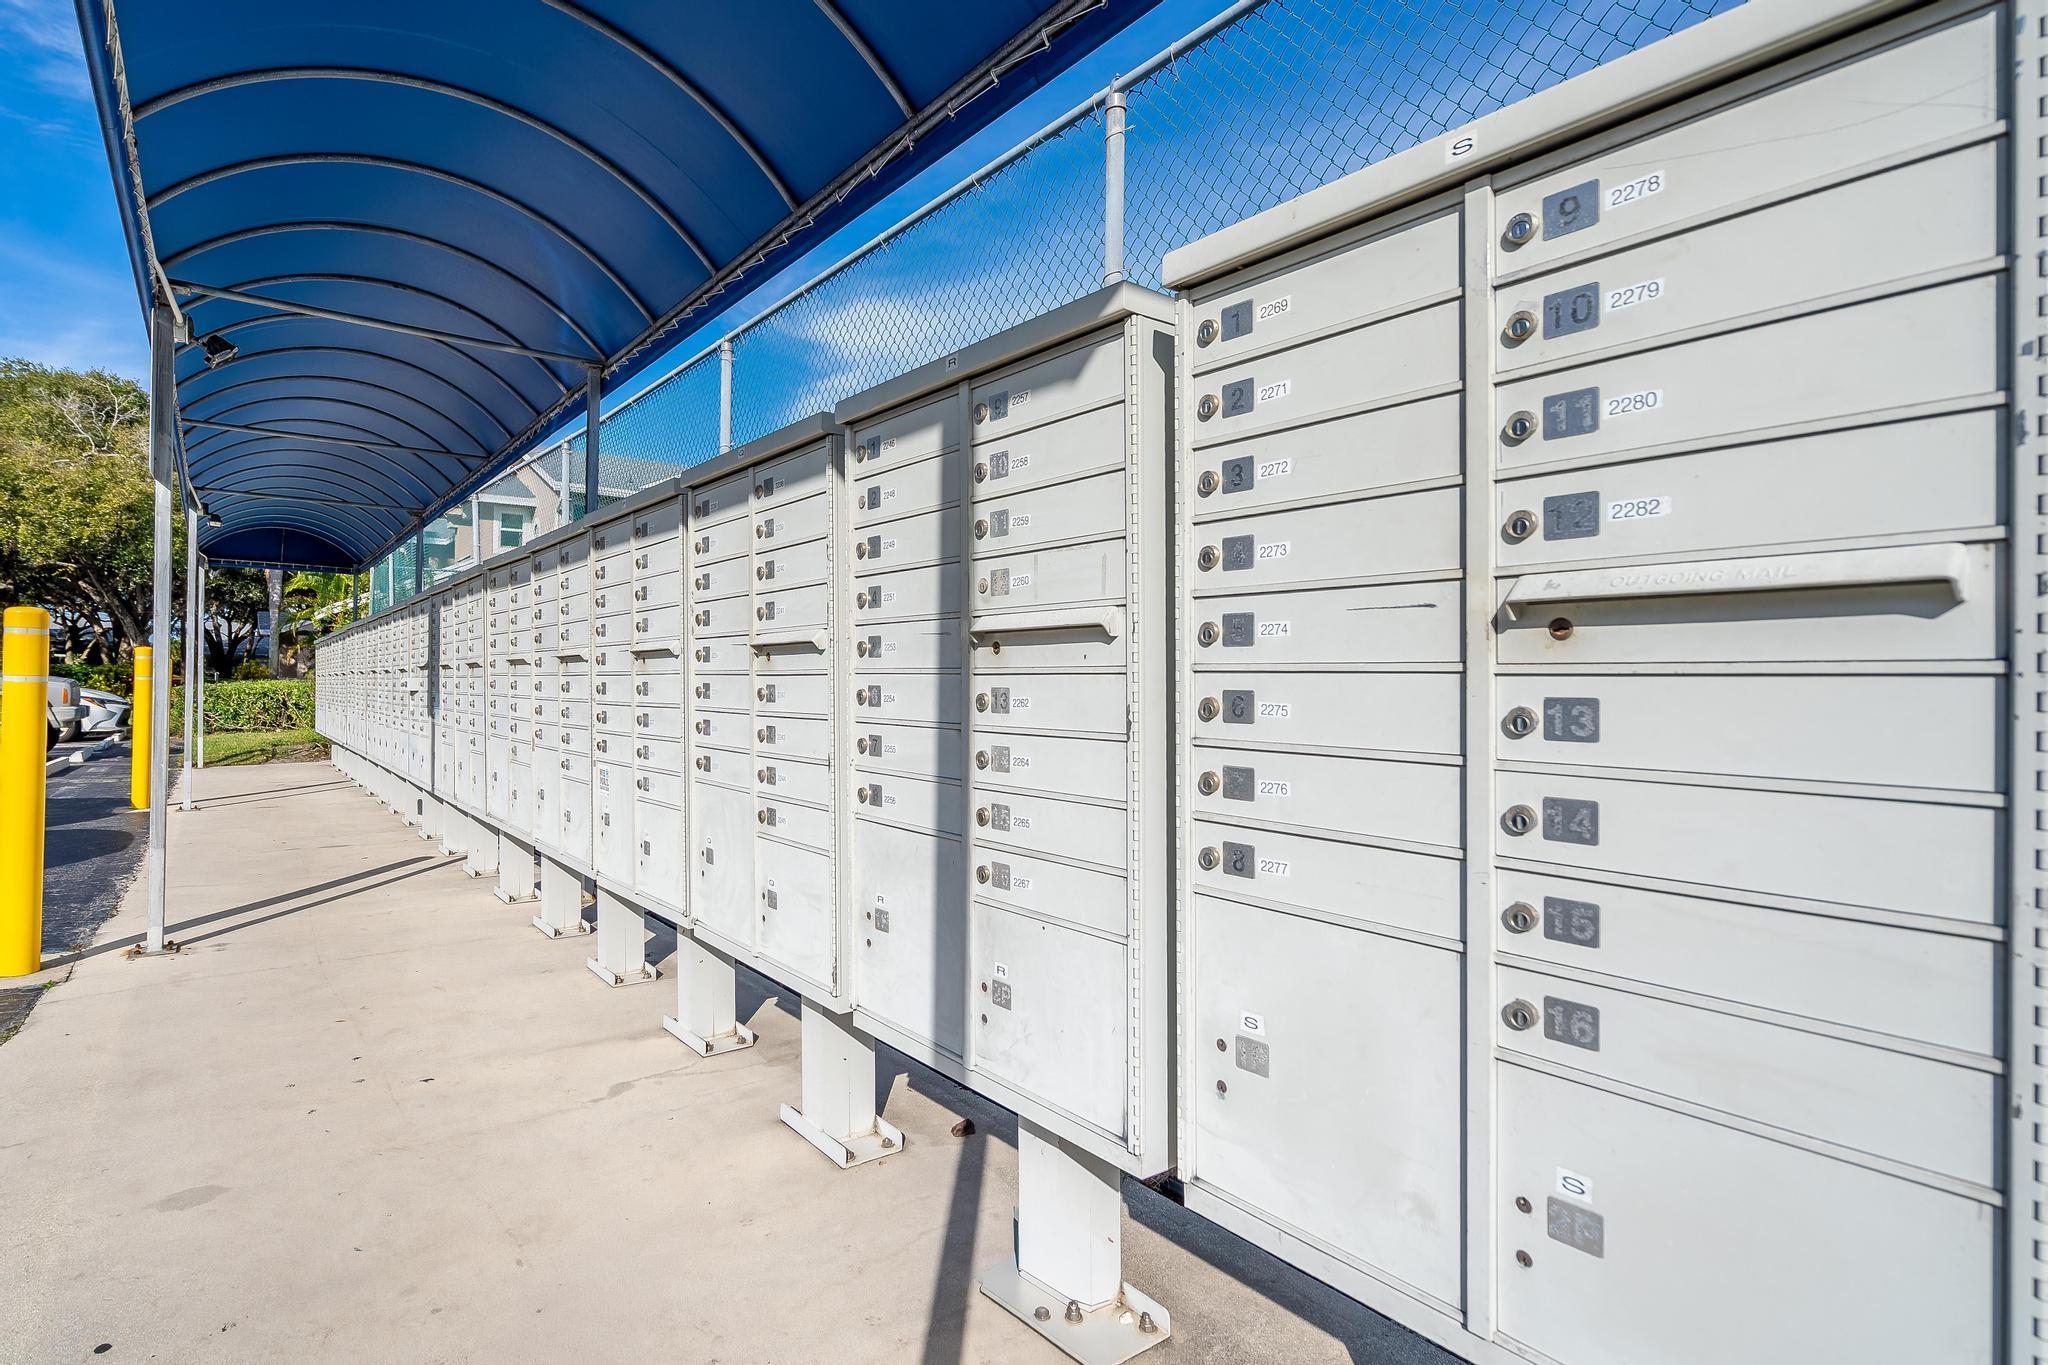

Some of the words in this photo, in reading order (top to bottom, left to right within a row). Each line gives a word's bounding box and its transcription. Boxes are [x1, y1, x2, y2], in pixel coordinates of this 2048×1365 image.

[1452, 137, 1473, 156] S
[1611, 175, 1661, 206] 2278
[1558, 195, 1581, 228] 9
[1610, 281, 1660, 309] 2279
[1260, 298, 1288, 319] 2269
[1548, 292, 1594, 330] 10
[1231, 309, 1240, 333] 1
[948, 357, 957, 368] R
[1012, 391, 1029, 406] 2257
[1232, 387, 1244, 411] 2
[1261, 382, 1287, 401] 2271
[1550, 394, 1593, 432] 11
[1609, 391, 1658, 416] 2280
[1011, 456, 1029, 470] 2258
[1261, 460, 1289, 478] 2272
[1231, 463, 1244, 487] 3
[871, 491, 877, 506] 2
[1548, 499, 1594, 533] 12
[1612, 498, 1661, 520] 2282
[1012, 516, 1029, 527] 2259
[1260, 543, 1287, 559] 2273
[1012, 575, 1029, 587] 2260
[1609, 568, 1726, 589] OUTGOING
[1736, 564, 1799, 582] MAIL
[1260, 623, 1288, 636] 2274
[992, 692, 1008, 710] 13
[1012, 698, 1029, 708] 2262
[1231, 695, 1245, 719] 6
[1260, 703, 1288, 717] 2275
[1547, 703, 1596, 737] 13
[872, 738, 877, 753] 7
[1012, 756, 1030, 768] 2264
[1260, 781, 1288, 796] 2276
[1013, 816, 1030, 829] 2265
[1544, 805, 1592, 840] 14
[1232, 849, 1245, 873] 8
[1260, 860, 1288, 875] 2277
[1013, 877, 1030, 889] 2267
[877, 895, 884, 904] R
[1548, 904, 1595, 941] 15
[996, 965, 1005, 976] R
[1244, 1016, 1258, 1030] S
[1548, 1005, 1595, 1043] 16
[1561, 1176, 1585, 1195] S
